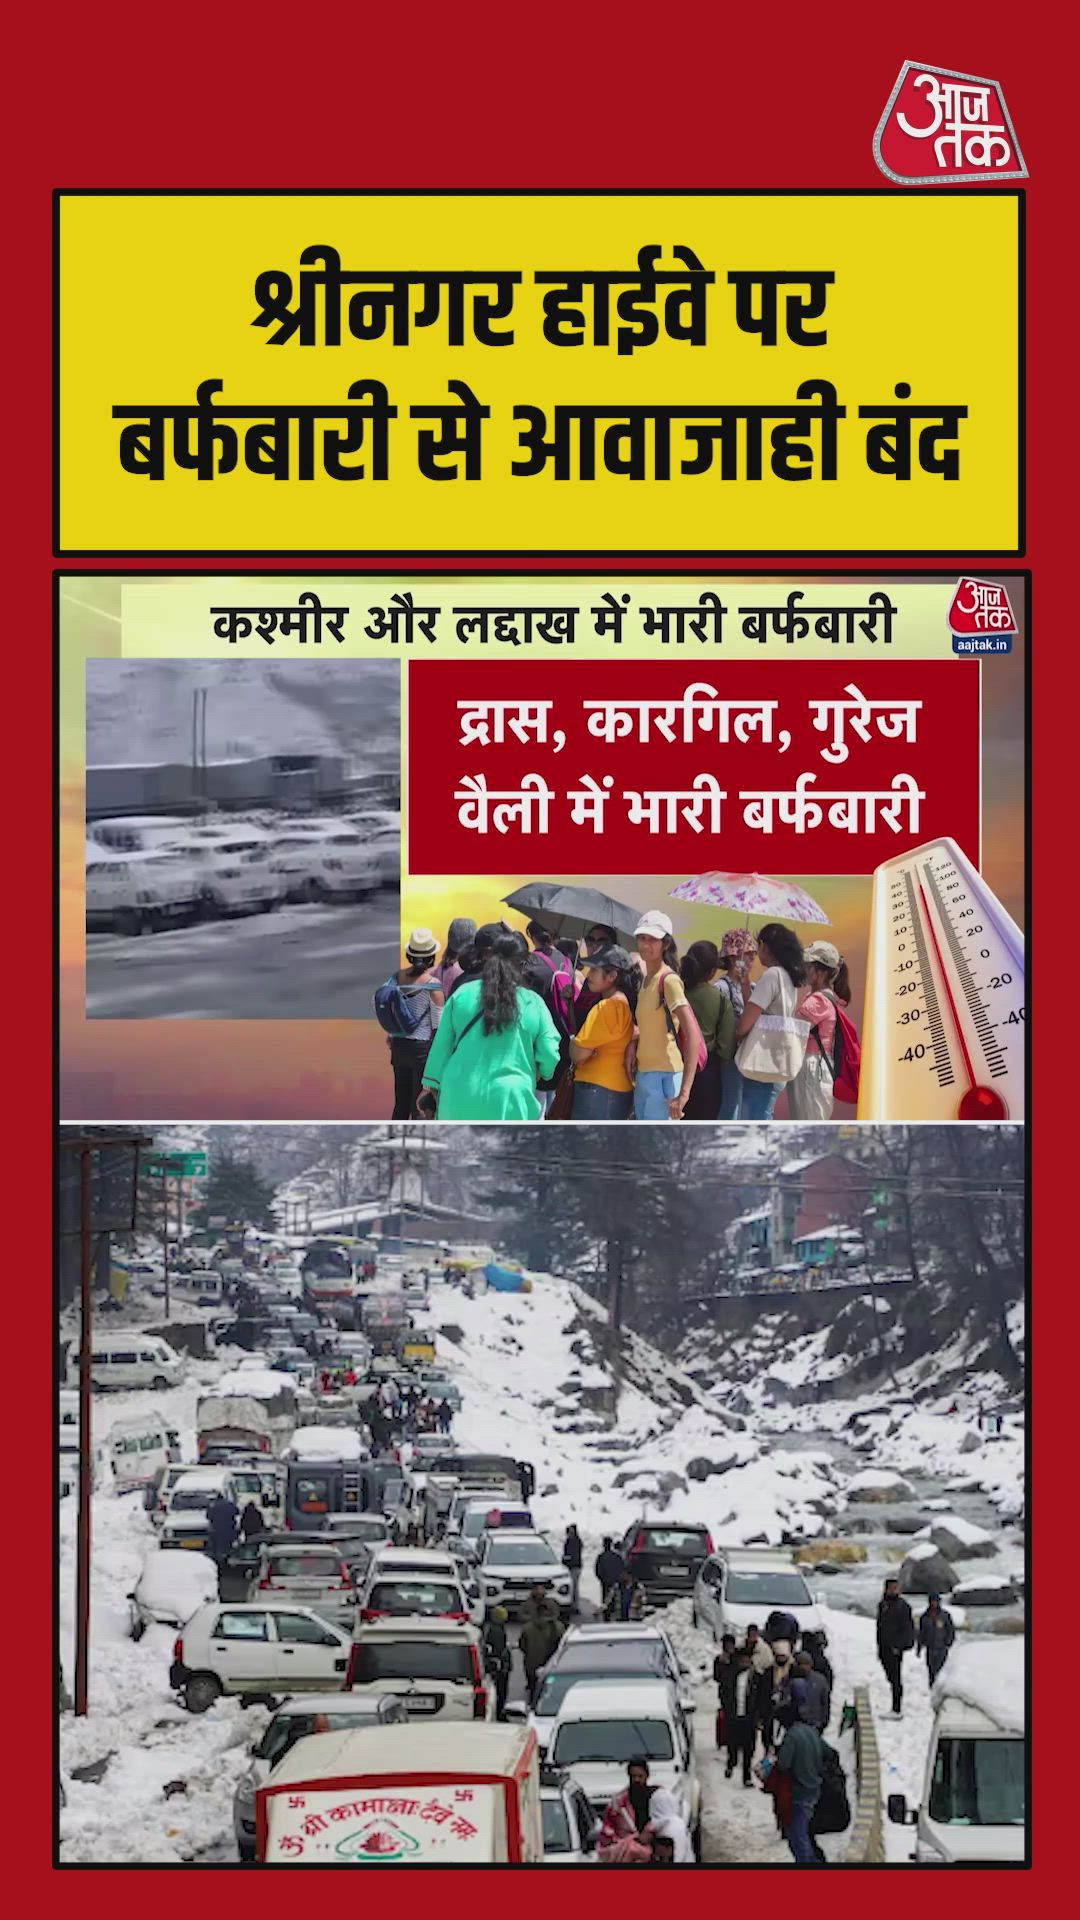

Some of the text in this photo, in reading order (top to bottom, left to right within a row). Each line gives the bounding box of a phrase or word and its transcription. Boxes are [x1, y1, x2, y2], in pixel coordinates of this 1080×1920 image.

[951, 894, 966, 904] 60
[892, 912, 905, 923] 20
[958, 908, 974, 919] 40
[894, 926, 907, 936] 10
[966, 924, 983, 937] 20
[897, 943, 906, 951] 0
[980, 948, 990, 958] 0
[893, 960, 914, 973] -10
[986, 972, 1012, 989] -20
[894, 981, 916, 997] -20
[896, 1009, 920, 1025] -30
[898, 1043, 925, 1062] -40
